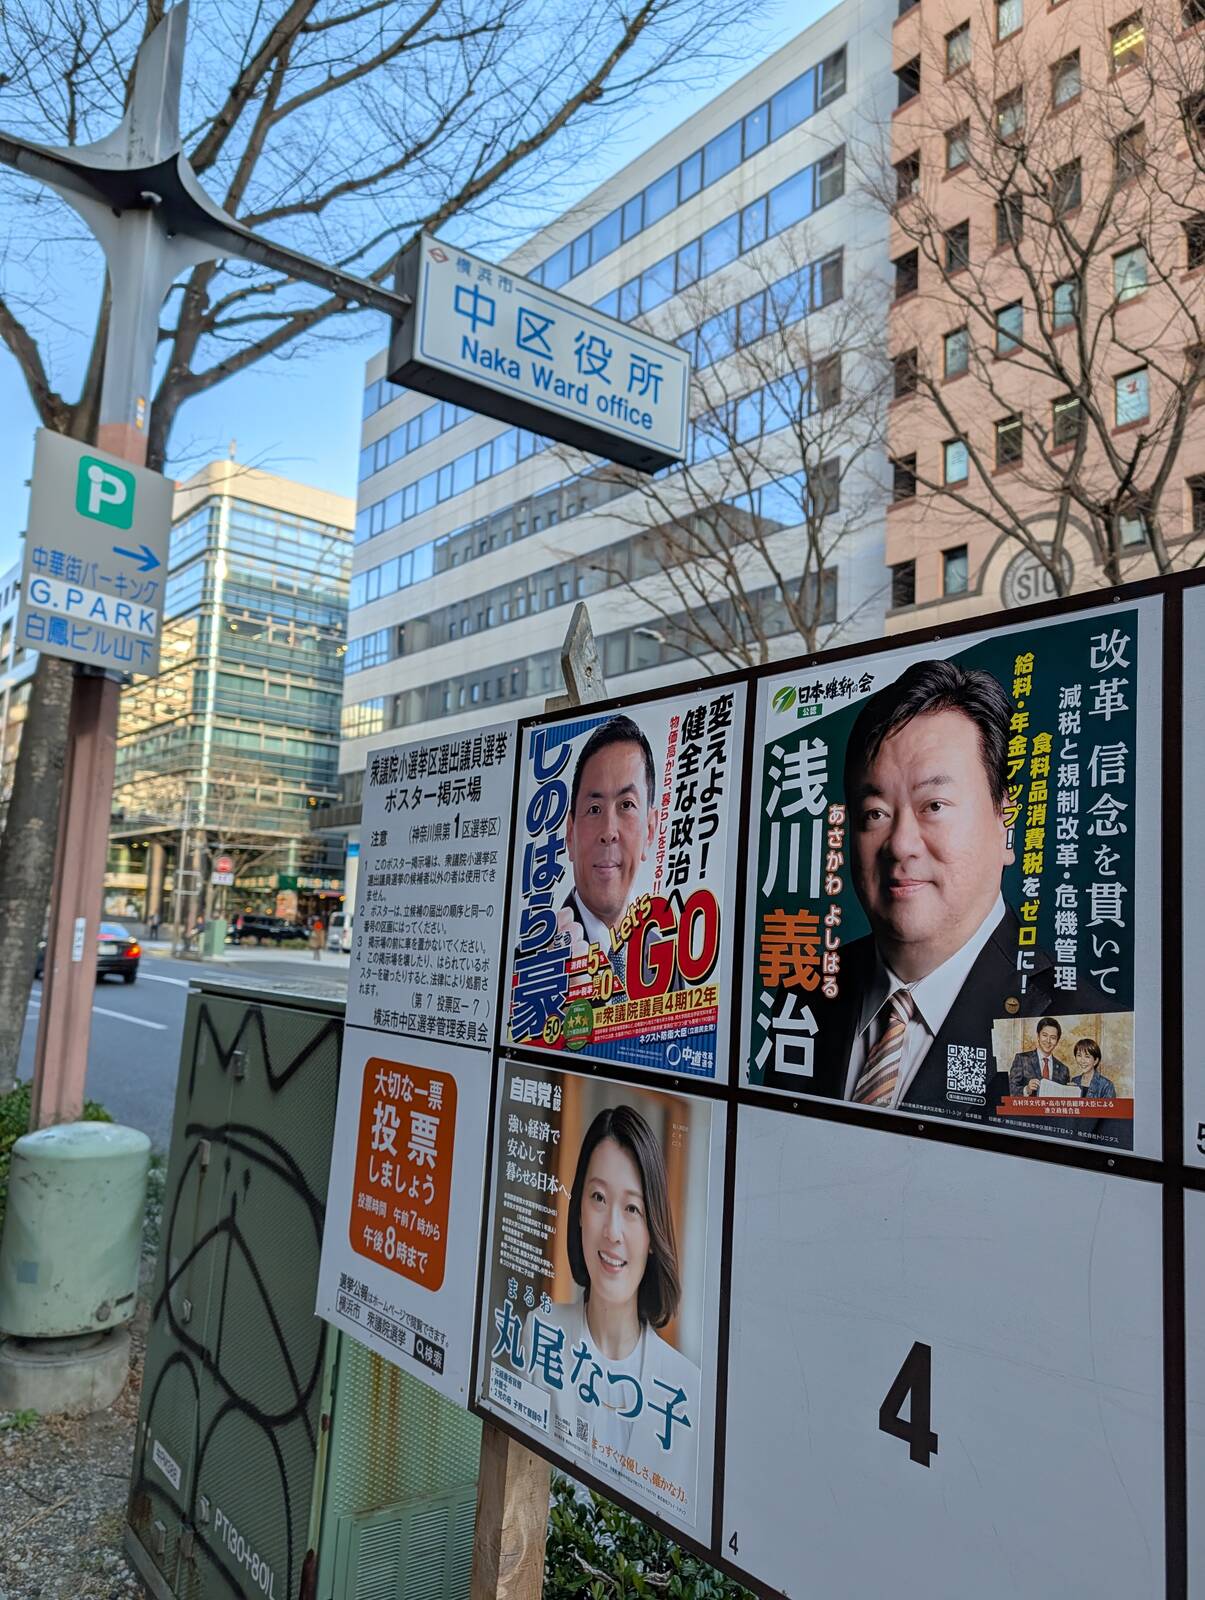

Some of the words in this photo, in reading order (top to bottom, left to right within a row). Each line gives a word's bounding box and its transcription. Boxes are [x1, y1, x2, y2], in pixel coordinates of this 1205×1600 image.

[456, 256, 514, 293] 横浜市
[454, 284, 664, 404] 中区役所
[461, 335, 521, 379] Naka
[532, 362, 587, 406] Ward
[597, 392, 653, 430] office
[32, 546, 159, 606] 中華街パーキング
[30, 579, 154, 634] G.PARK
[799, 672, 875, 704] 日本維新の会
[1088, 628, 1132, 722] 改革
[369, 731, 508, 788] 衆議院小選挙区選出議員選挙
[1003, 651, 1035, 850] 給料・年金アップ！
[384, 775, 483, 814] ポスター掲示場
[664, 705, 707, 914] 健全な政治へ
[370, 831, 388, 847] 注意
[824, 803, 846, 896] あさかわ
[1016, 731, 1053, 995] 食料品消費税をゼロに！
[1053, 684, 1082, 992] 減税と規制改革・危機管理
[1084, 740, 1130, 995] 信念を貫いて
[359, 904, 366, 917] 2
[755, 737, 829, 1078] 浅川義治
[626, 889, 720, 1001] GO
[821, 903, 842, 999] よしはる
[373, 1008, 488, 1044] 横浜市中区選挙管理委員会
[373, 1067, 444, 1111] 大切な一票
[509, 1076, 552, 1111] 自民党
[370, 1100, 440, 1169] 投票
[506, 1137, 546, 1166] 安心して
[507, 1114, 561, 1146] 強い経済で
[368, 1154, 436, 1206] しましょう
[505, 1160, 572, 1200] 暮らせる日本へ。
[363, 1225, 429, 1275] 午後8時まで
[491, 1300, 692, 1451] 丸尾なつ子
[879, 1341, 938, 1468] 4
[728, 1531, 739, 1556] 4
